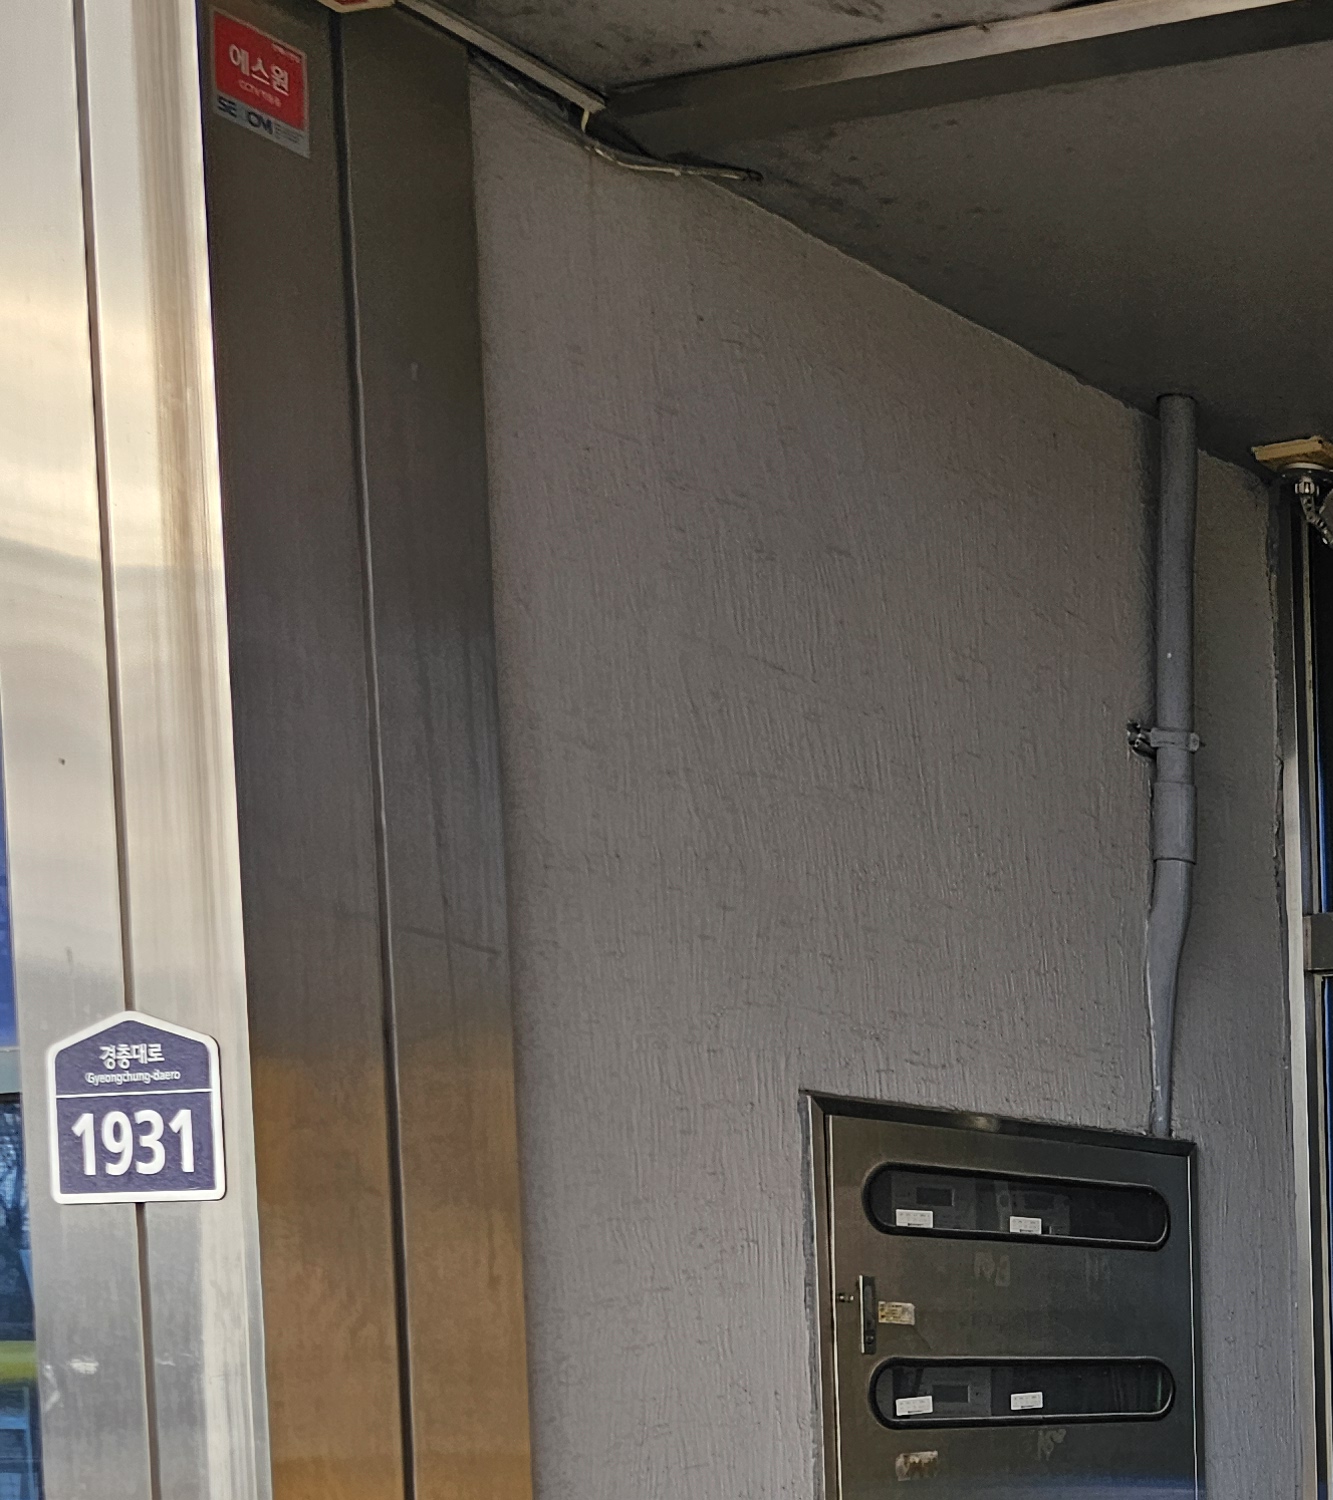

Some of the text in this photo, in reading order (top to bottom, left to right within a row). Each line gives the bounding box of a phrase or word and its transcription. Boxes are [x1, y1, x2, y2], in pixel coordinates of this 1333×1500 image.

[228, 44, 290, 97] 에스원
[99, 1043, 166, 1070] 경충대로
[85, 1068, 181, 1086] Gyeongchung-daero
[71, 1109, 195, 1176] 1931
